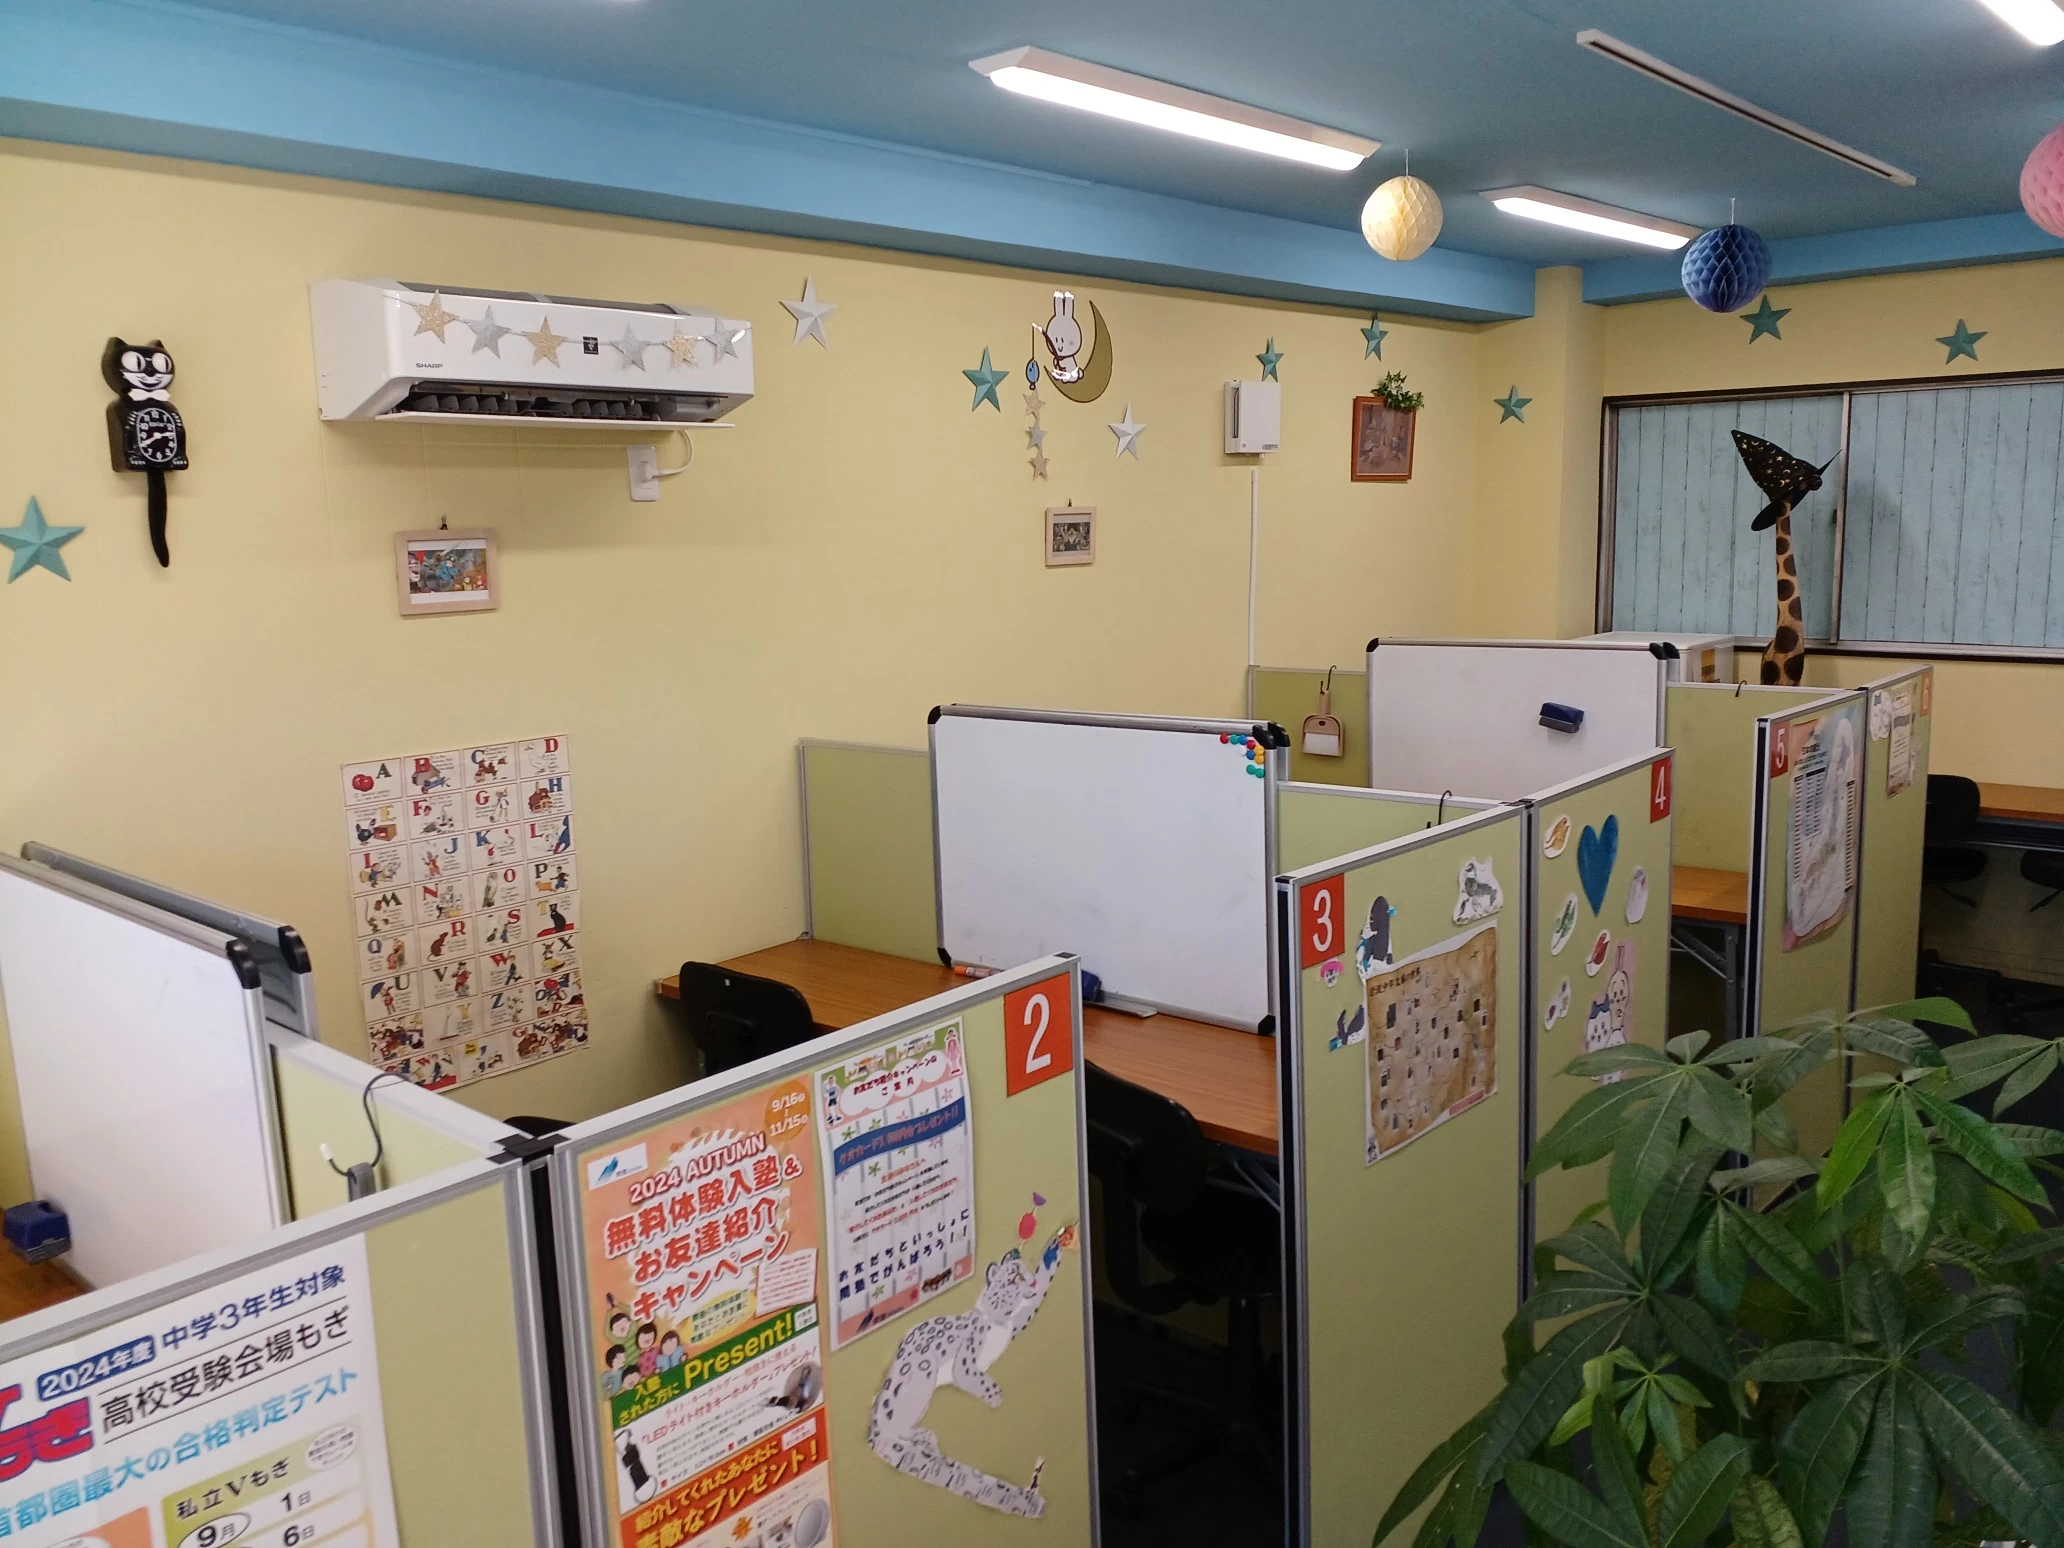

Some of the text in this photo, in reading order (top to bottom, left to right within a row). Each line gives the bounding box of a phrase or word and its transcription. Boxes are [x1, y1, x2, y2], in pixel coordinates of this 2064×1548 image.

[415, 362, 443, 370] SHARP
[376, 763, 393, 779] A
[414, 757, 431, 774] B
[471, 749, 486, 765] C
[544, 738, 559, 753] D
[1774, 728, 1786, 768] 5
[475, 790, 490, 806] G
[548, 777, 563, 794] H
[1655, 765, 1667, 811] 4
[444, 837, 458, 854] J
[475, 830, 492, 847] K
[529, 823, 545, 838] L
[381, 863, 548, 907] M N O P
[450, 920, 466, 938] R
[508, 909, 521, 925] S
[1312, 889, 1333, 952] 3
[394, 973, 410, 991] U
[433, 966, 448, 982] V
[558, 935, 575, 952] X
[490, 992, 505, 1010] Z
[1023, 993, 1052, 1074] 2
[629, 1131, 768, 1206] 2024 AUTUMN
[633, 1195, 778, 1284] お友達紹介
[838, 1207, 970, 1283] お友だちといっしょに
[633, 1231, 789, 1322] キャンペーン
[41, 1263, 346, 1398] 2024年度 中学3年生対象
[683, 1312, 794, 1390] Present!
[101, 1304, 350, 1436] 高校受験会場もぎ
[619, 1382, 680, 1426] された方に
[176, 1456, 290, 1521] 私立Vもぎ
[634, 1440, 779, 1534] 紹介してくれたあなたに
[196, 1490, 312, 1548] 9月 1日
[282, 1523, 316, 1548] 6日
